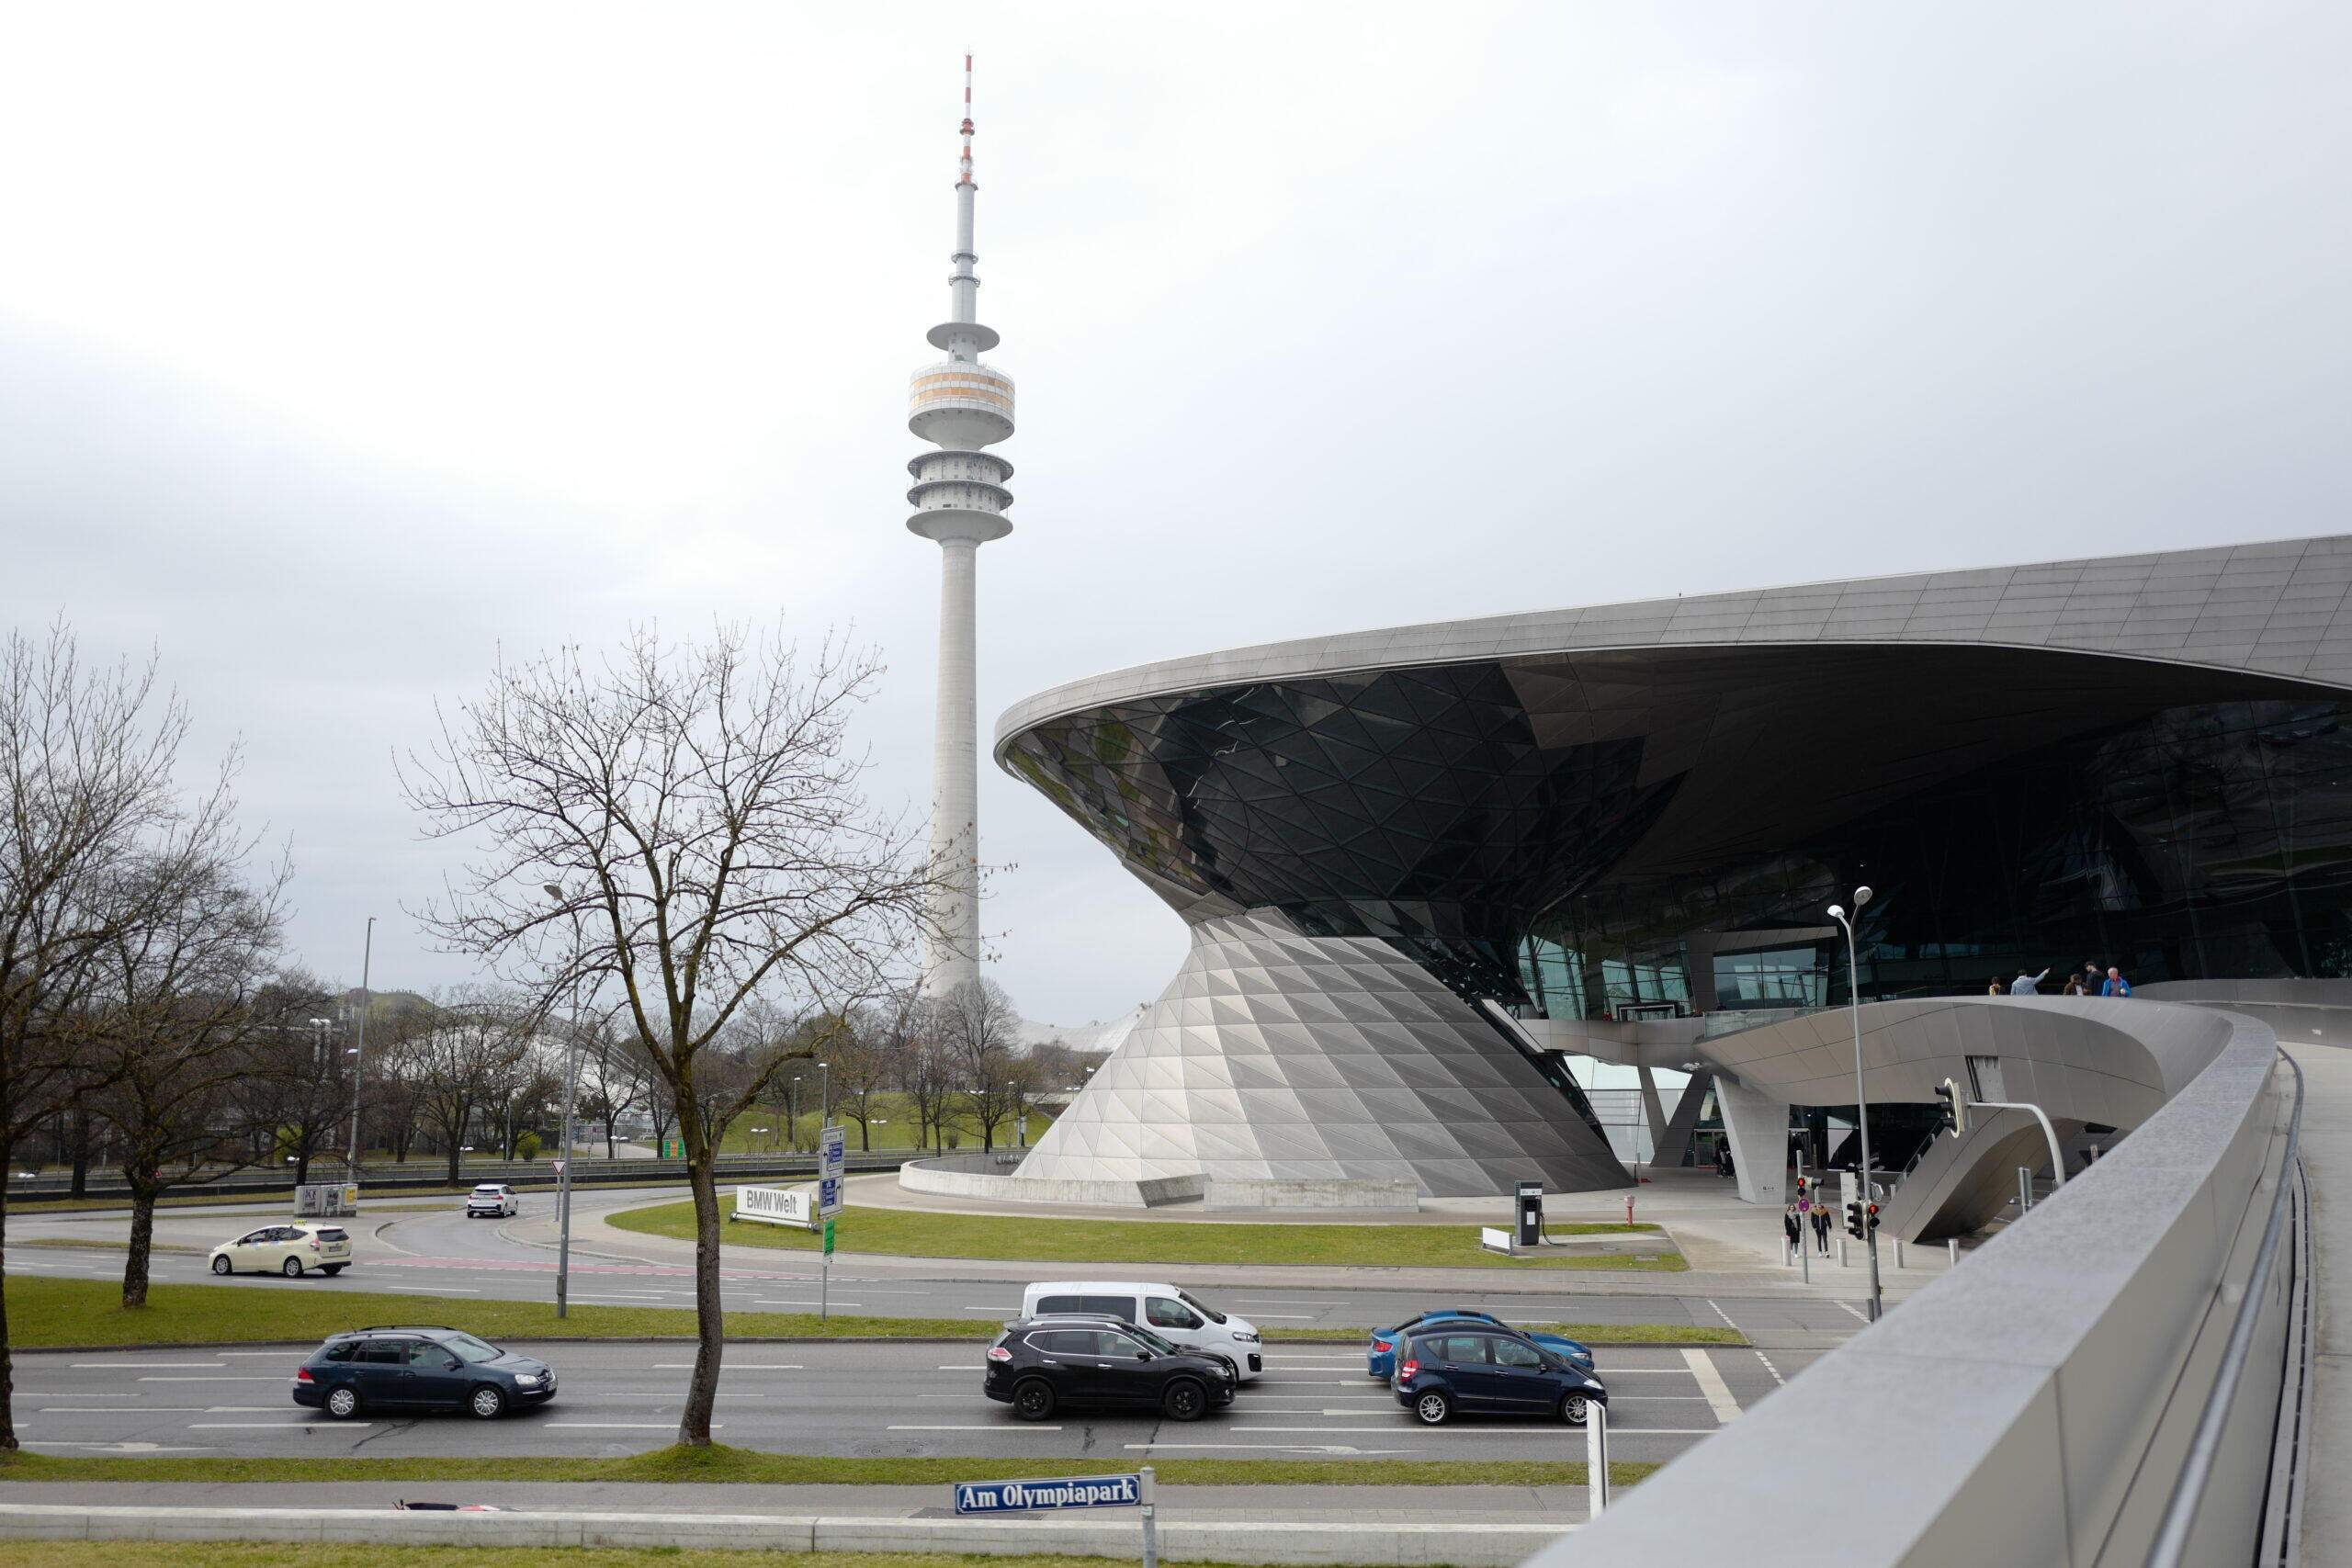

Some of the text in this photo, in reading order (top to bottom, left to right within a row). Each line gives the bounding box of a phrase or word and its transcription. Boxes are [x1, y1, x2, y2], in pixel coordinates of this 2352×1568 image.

[747, 1190, 772, 1211] BMW
[774, 1192, 797, 1214] Welt
[962, 1478, 1136, 1509] Am Olympiapark
